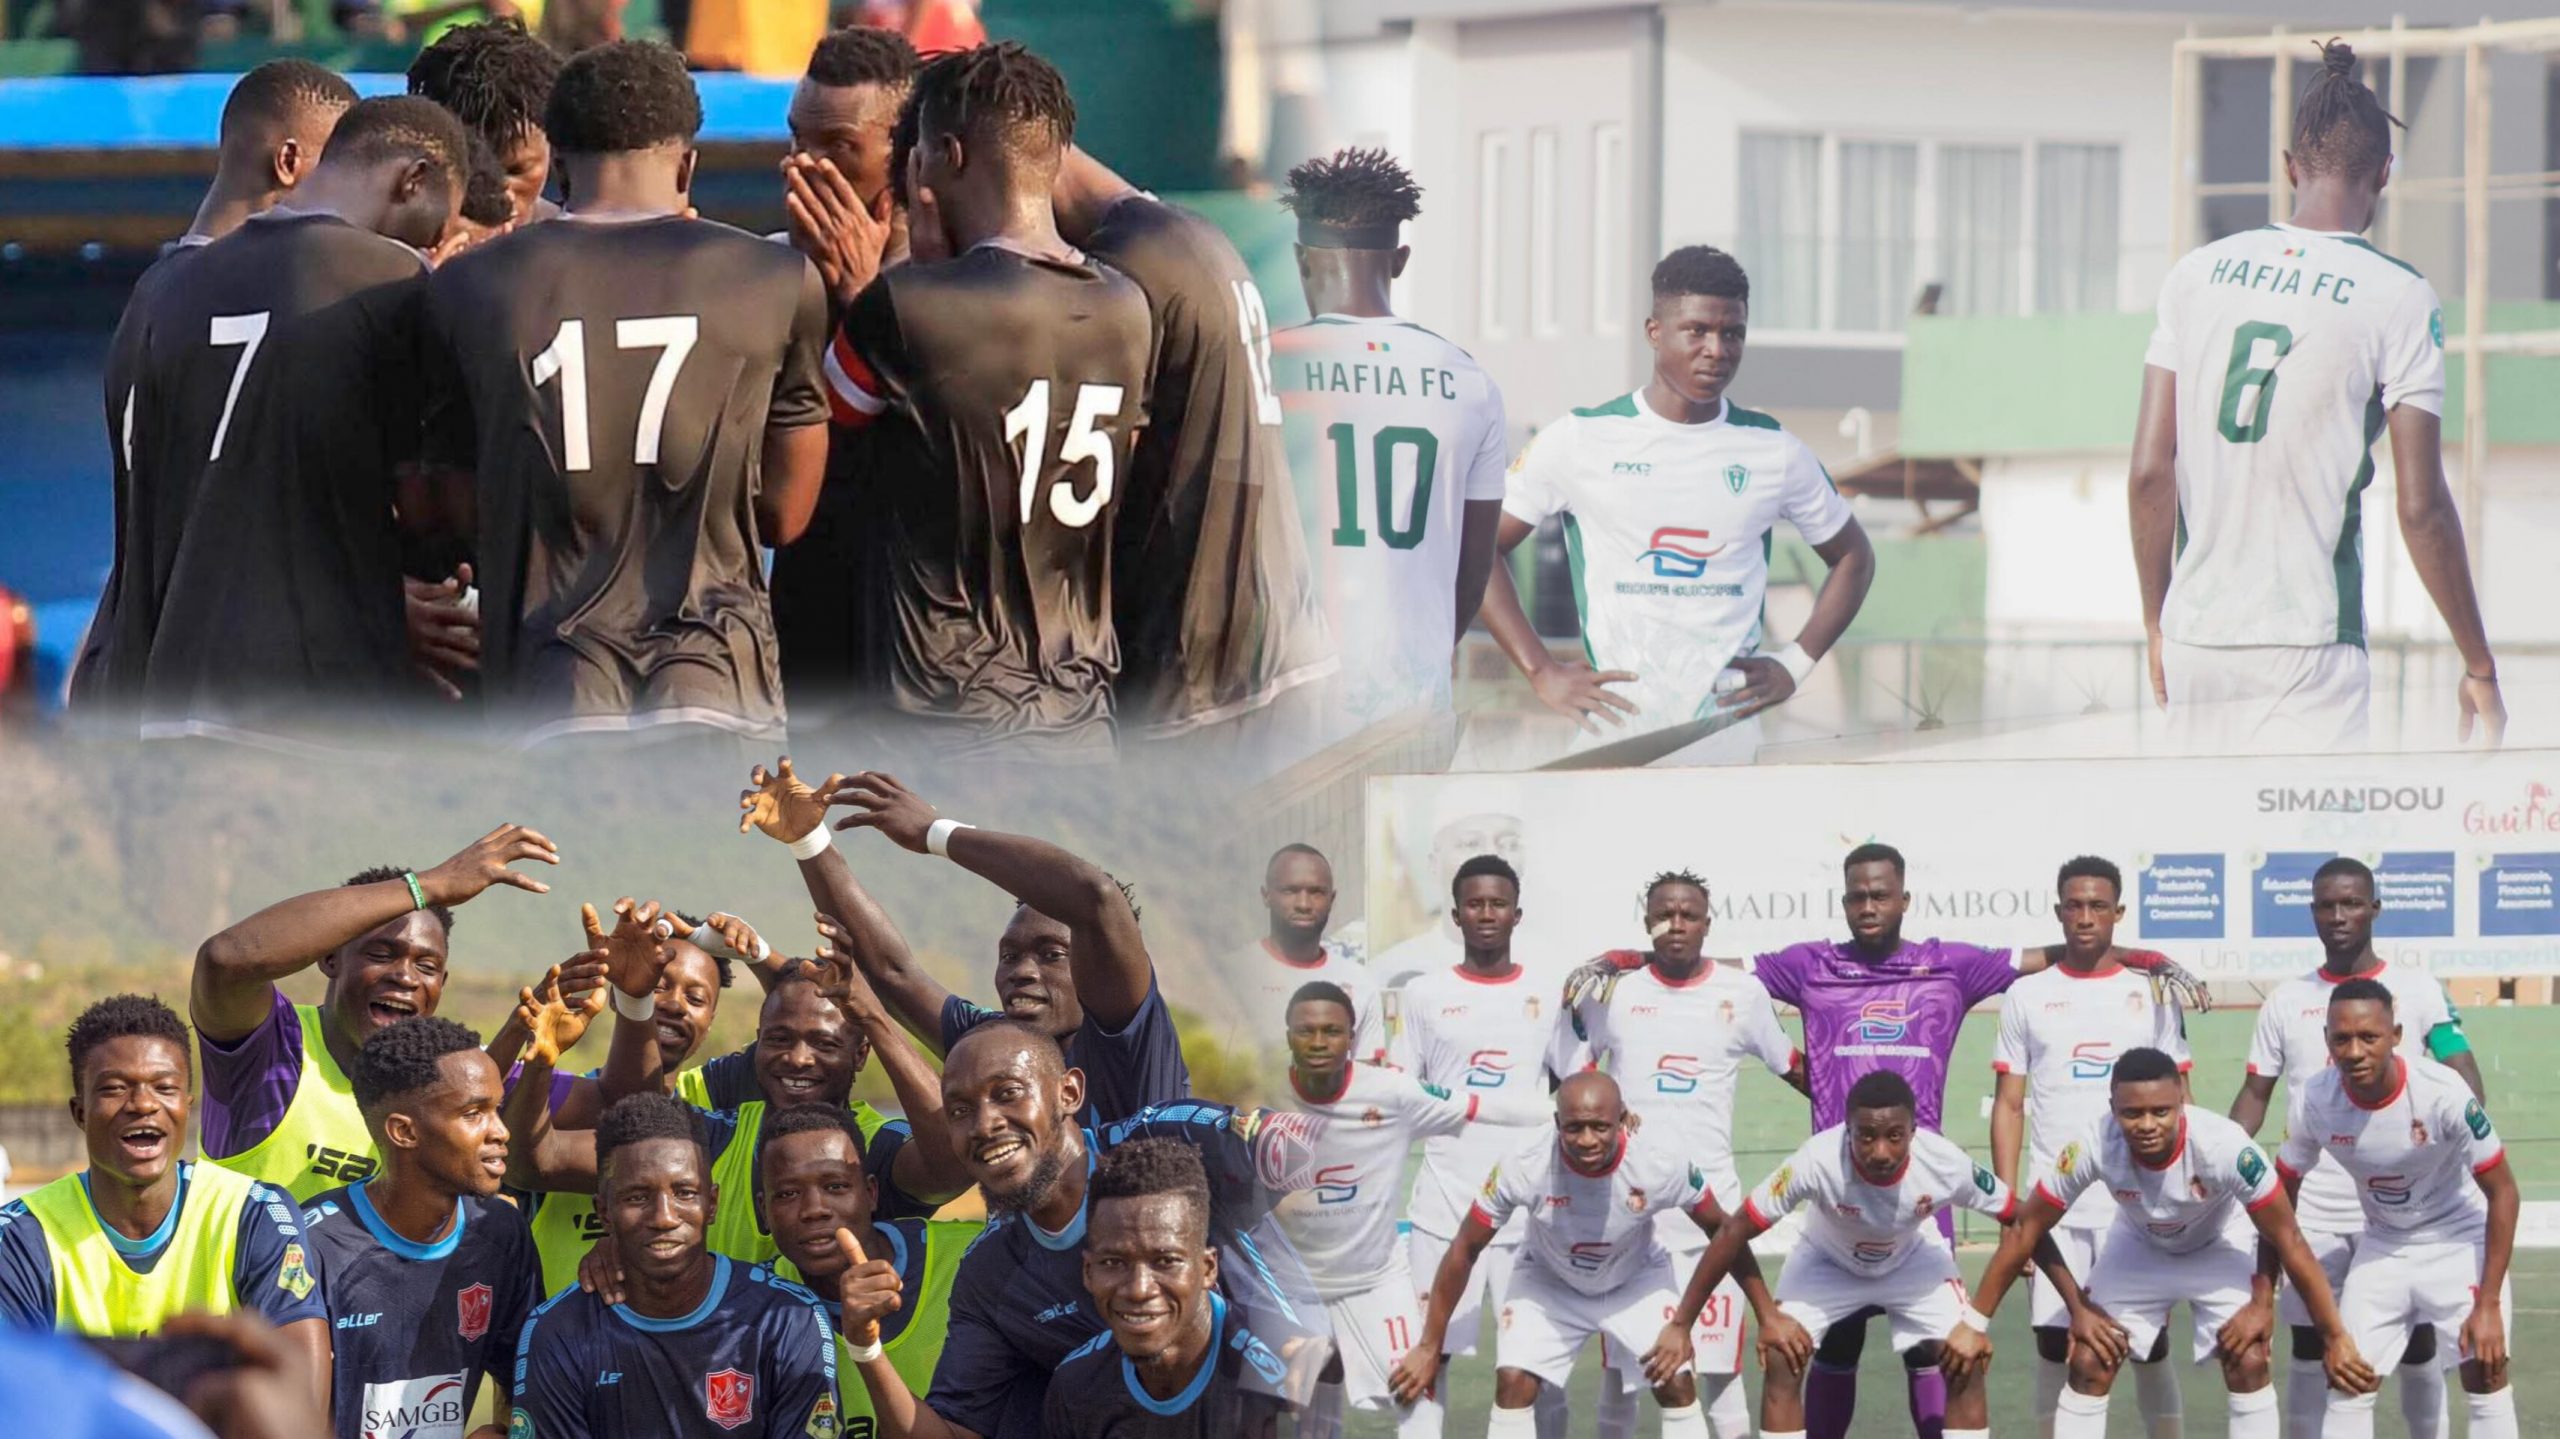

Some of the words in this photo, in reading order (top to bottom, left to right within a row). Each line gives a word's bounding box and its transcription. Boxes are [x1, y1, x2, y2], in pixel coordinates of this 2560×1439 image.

[2210, 258, 2300, 295] HAFIA
[2311, 272, 2356, 305] FC
[208, 310, 271, 462] 7
[532, 315, 698, 472] 17
[1305, 361, 1408, 397] HAFIA
[1421, 367, 1457, 401] FC
[2217, 319, 2294, 444] 6
[1004, 378, 1124, 528] 15
[1326, 422, 1439, 550] 10
[2257, 786, 2445, 813] SIMANDOU
[1384, 1315, 1409, 1351] 11
[1699, 1294, 1731, 1328] 31
[364, 1401, 460, 1431] SAMGB
